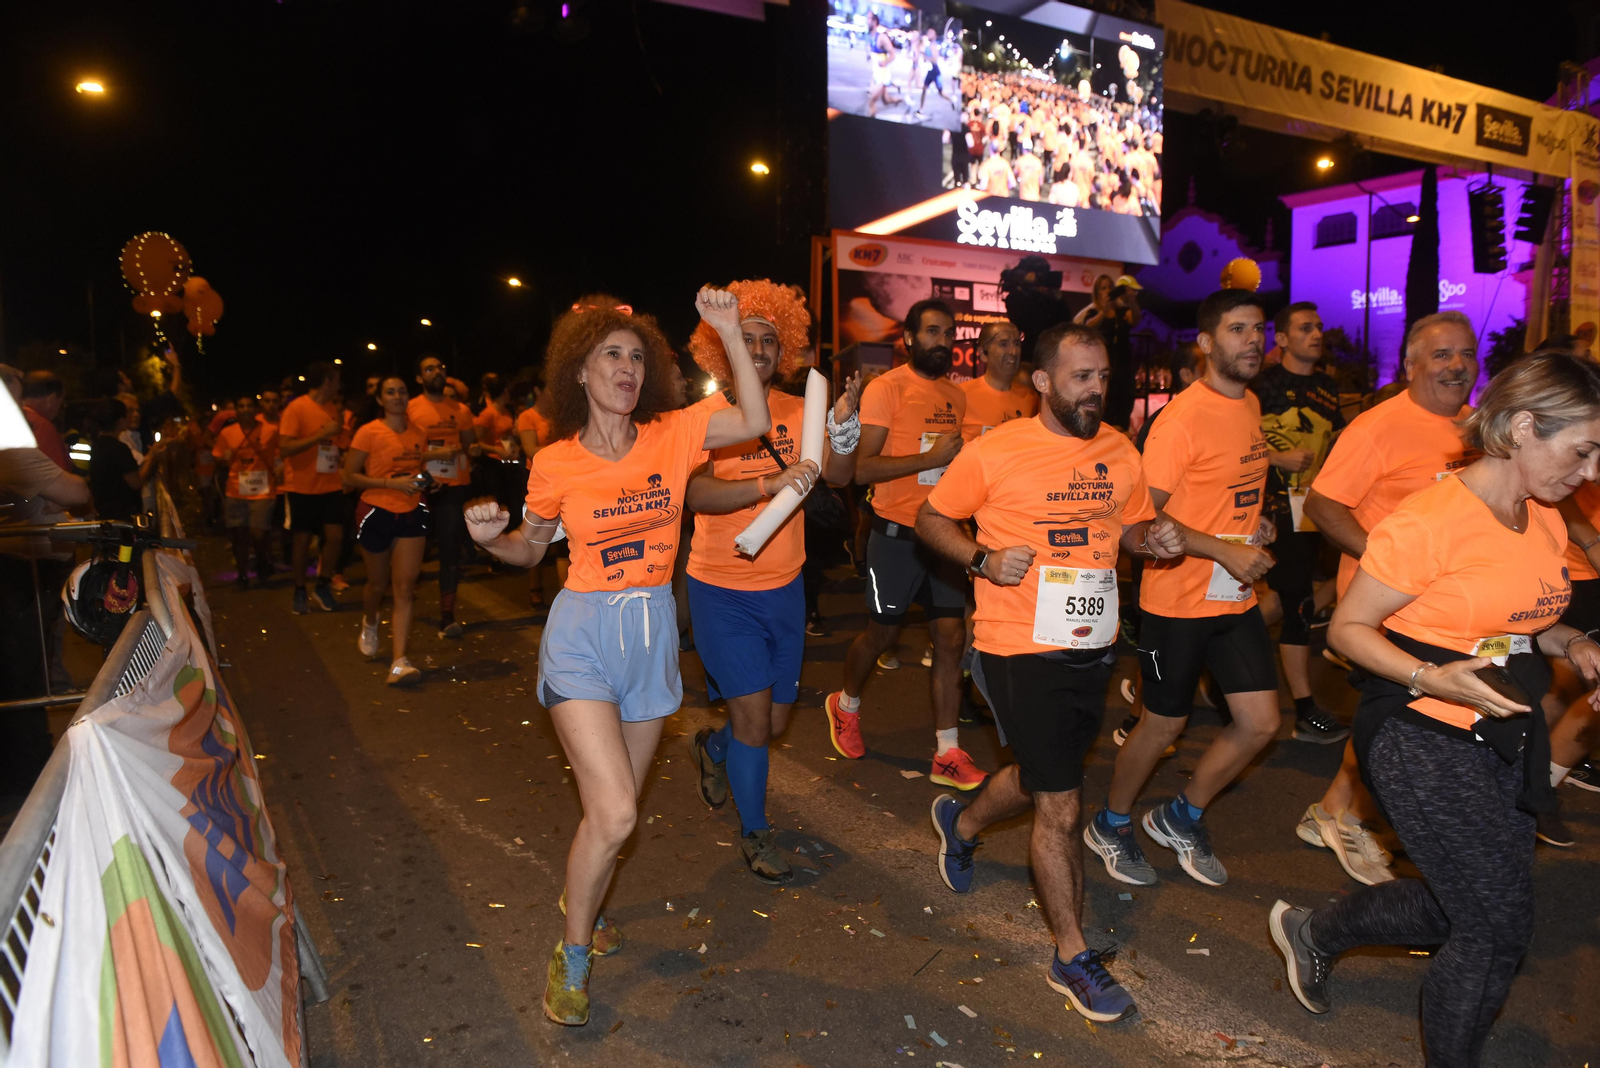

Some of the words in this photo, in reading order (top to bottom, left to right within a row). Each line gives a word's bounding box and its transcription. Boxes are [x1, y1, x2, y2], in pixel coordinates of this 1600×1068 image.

[1165, 28, 1312, 95] NOCTURNA
[1320, 70, 1413, 119] SEVILLA
[740, 450, 772, 461] SEVILL
[1068, 482, 1114, 490] NOCTURNA
[617, 488, 671, 505] NOCTURNA
[1046, 492, 1089, 501] SEVILLA
[593, 503, 643, 519] SEVILLA
[1065, 596, 1104, 616] 5389
